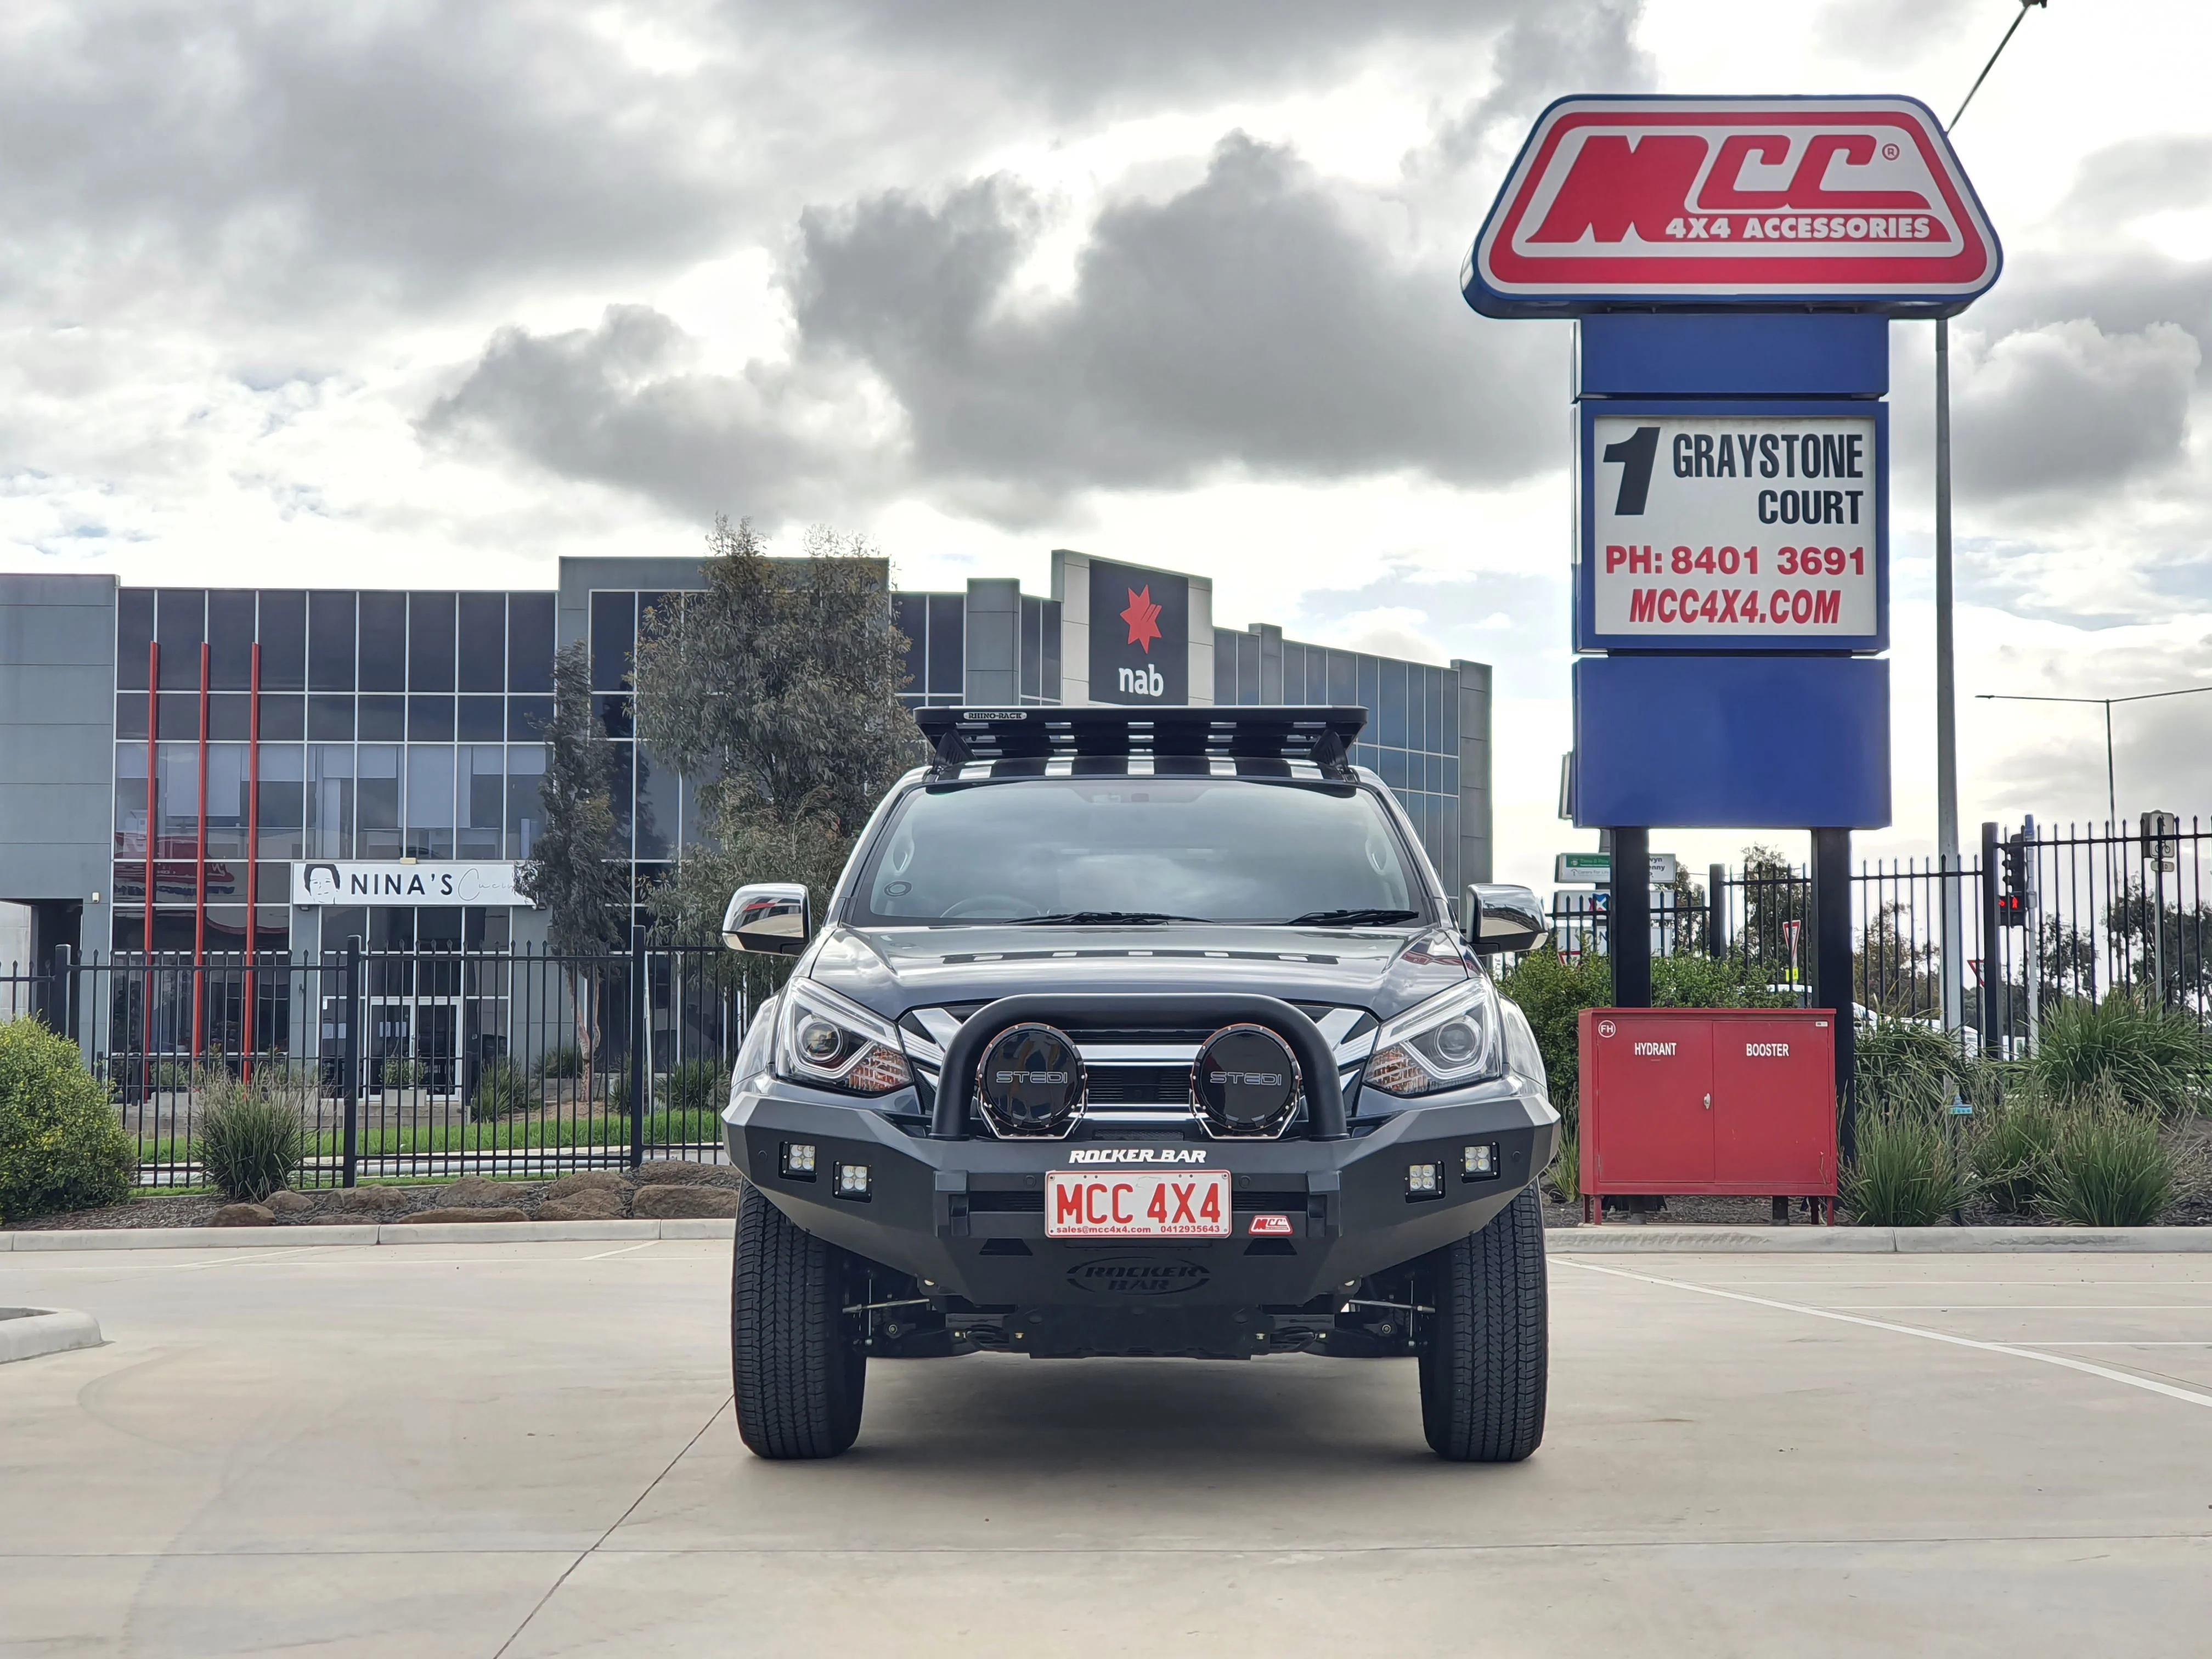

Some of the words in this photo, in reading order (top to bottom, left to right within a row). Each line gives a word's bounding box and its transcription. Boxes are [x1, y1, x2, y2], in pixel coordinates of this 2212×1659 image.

[1525, 135, 1932, 242] MCC
[1666, 217, 1731, 238] 4X4
[1742, 217, 1931, 239] ACCESSORIES
[1602, 427, 1661, 516] 1
[1673, 433, 1864, 478] GRAYSTONE
[1758, 490, 1864, 524] COURT
[1606, 545, 1663, 574] PH:
[1671, 546, 1758, 575] 8401
[1777, 546, 1864, 575] 3691
[1629, 589, 1841, 624] MCC4X4.COM
[1119, 664, 1164, 697] nab
[351, 873, 453, 895] NINA'S
[1601, 1025, 1613, 1033] FH
[1634, 1042, 1677, 1056] HYDRANT
[1746, 1043, 1790, 1057] BOOSTER
[996, 1071, 1068, 1084] STEDI
[1210, 1071, 1282, 1086] STEDI
[1069, 1149, 1155, 1164] ROCKER
[1161, 1149, 1206, 1163] BAR
[1056, 1183, 1133, 1224] MCC
[1147, 1183, 1221, 1223] 4X4
[1160, 1225, 1220, 1233] 0412935643
[1253, 1218, 1287, 1229] MCC
[1085, 1267, 1197, 1278] ROCKER
[1108, 1279, 1169, 1290] BAR
